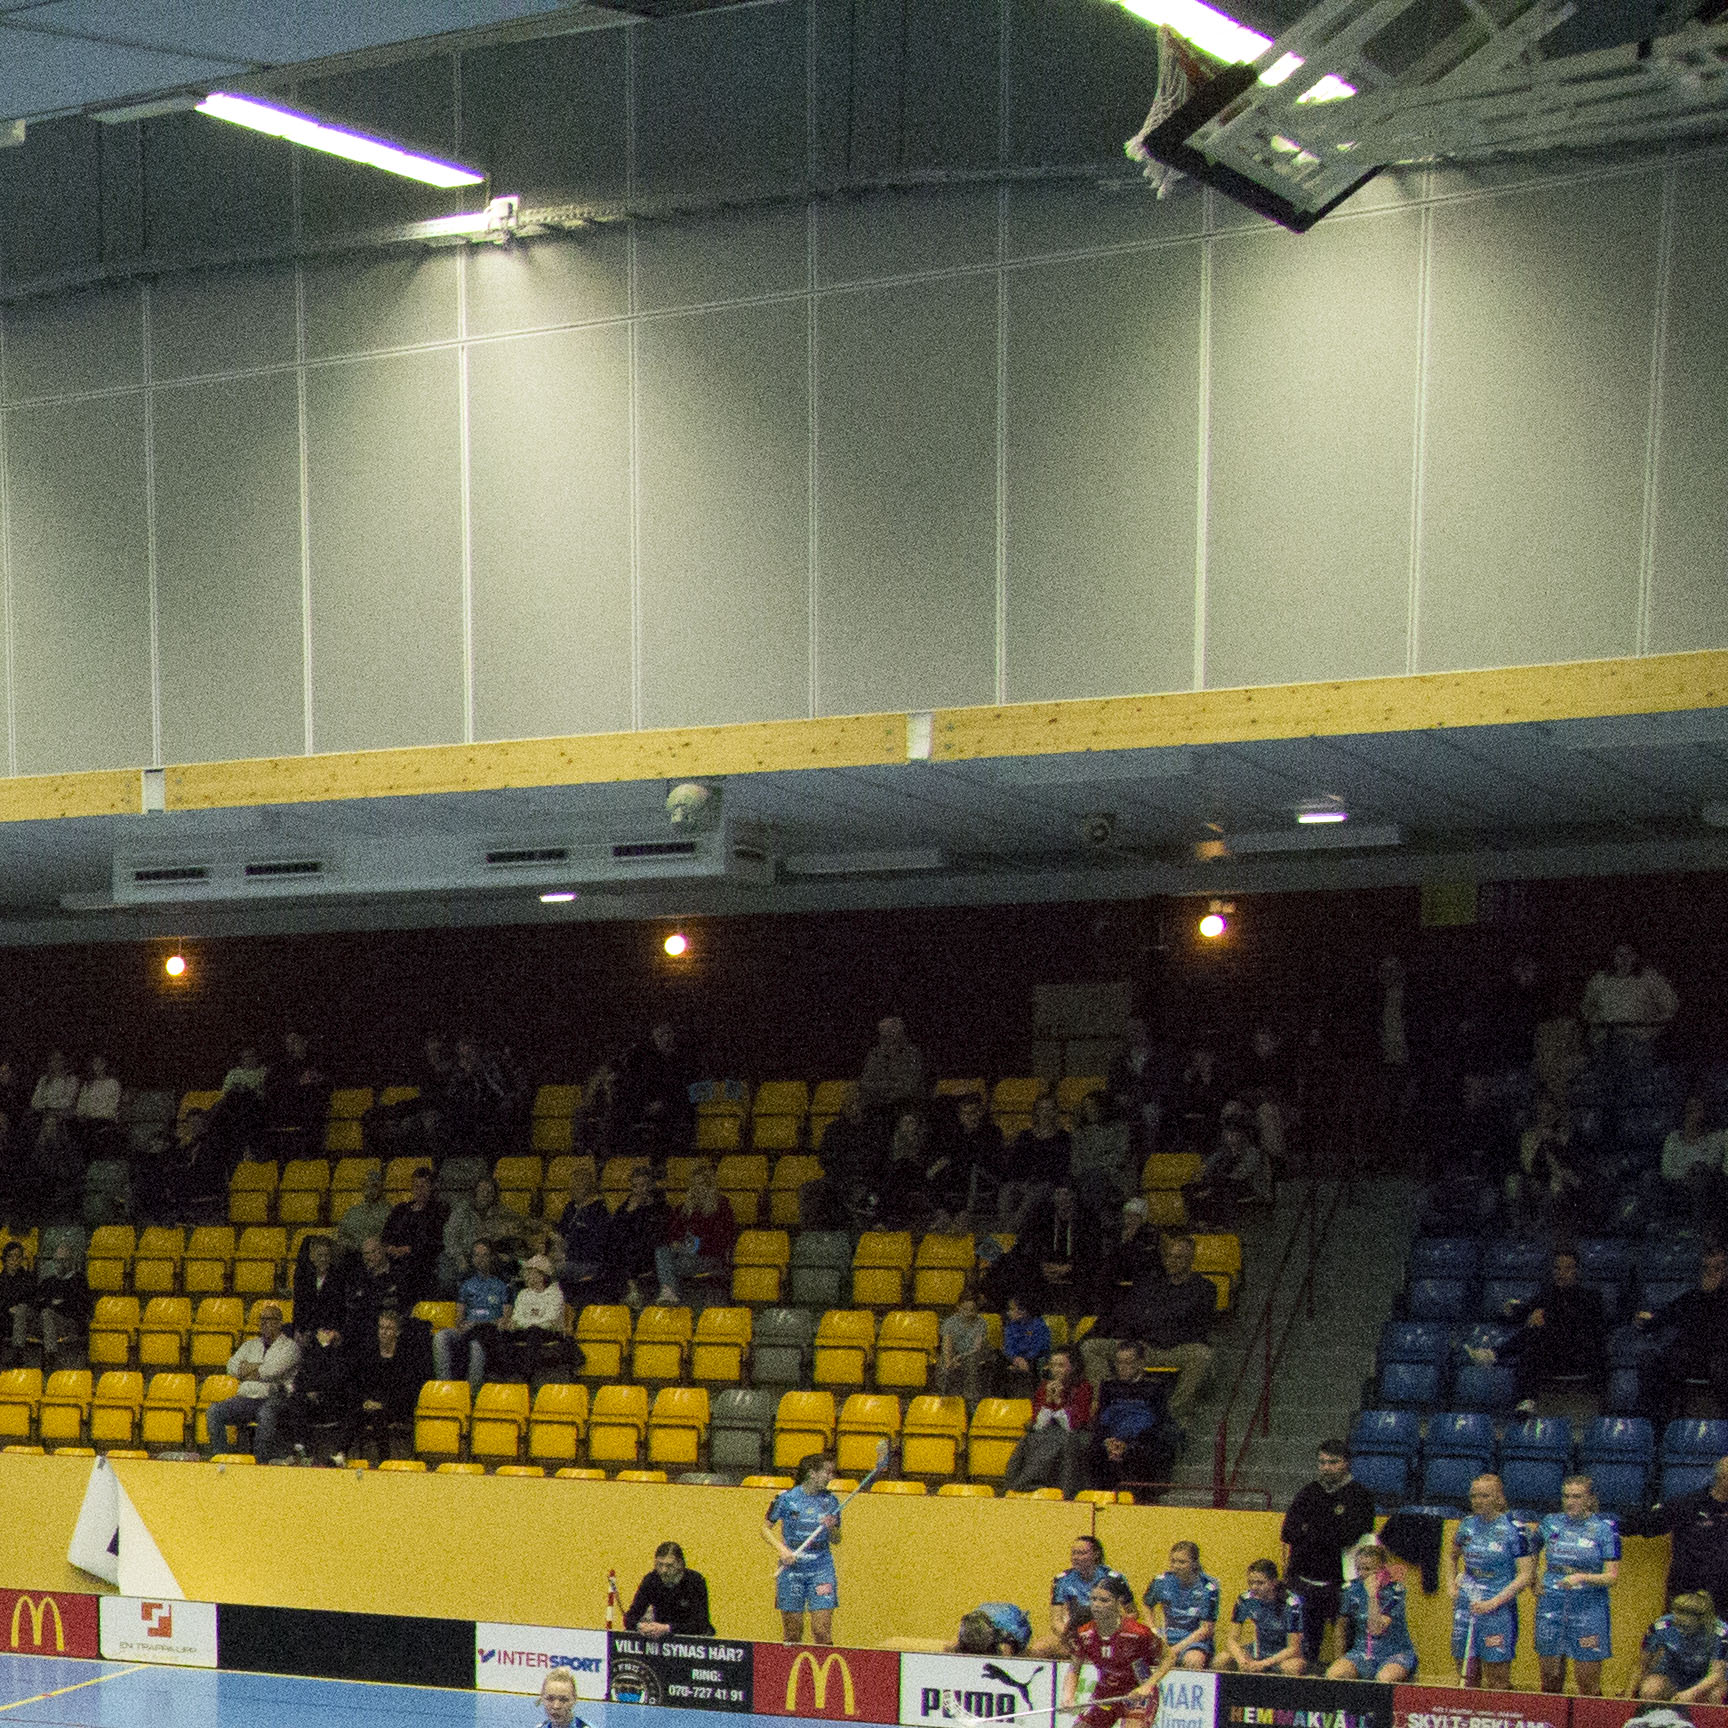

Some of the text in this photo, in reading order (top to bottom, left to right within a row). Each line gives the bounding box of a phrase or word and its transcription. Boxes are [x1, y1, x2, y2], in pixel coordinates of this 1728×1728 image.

[497, 1648, 603, 1673] INTERSPORT
[615, 1638, 643, 1655] VILL
[661, 1642, 706, 1661] SYNAS
[708, 1644, 745, 1663] HÄR?
[667, 1684, 712, 1700] 070-727
